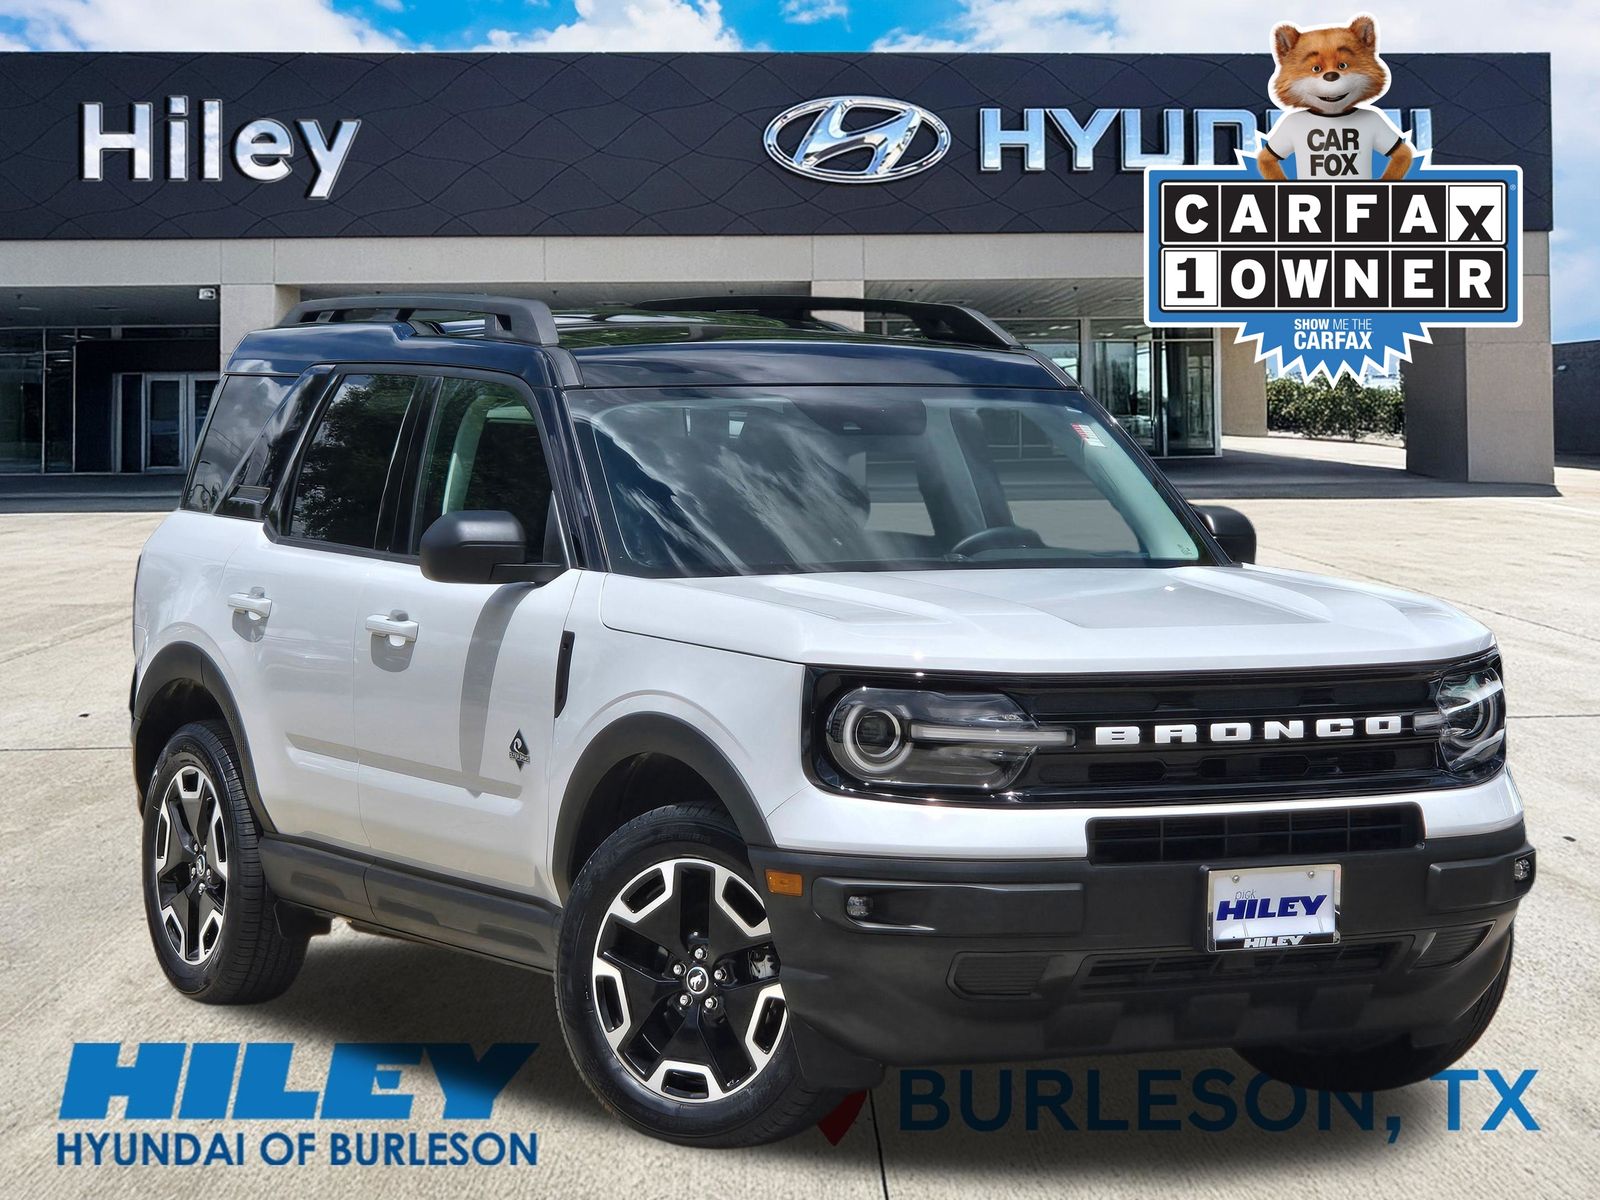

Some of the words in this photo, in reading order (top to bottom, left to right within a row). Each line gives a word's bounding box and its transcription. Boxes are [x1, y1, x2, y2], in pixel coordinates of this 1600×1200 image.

[80, 96, 361, 198] Hiley
[979, 108, 1433, 172] HYUNI
[1095, 716, 1402, 746] BRONCO
[1216, 894, 1328, 921] HILEY
[1243, 935, 1304, 949] HILEY
